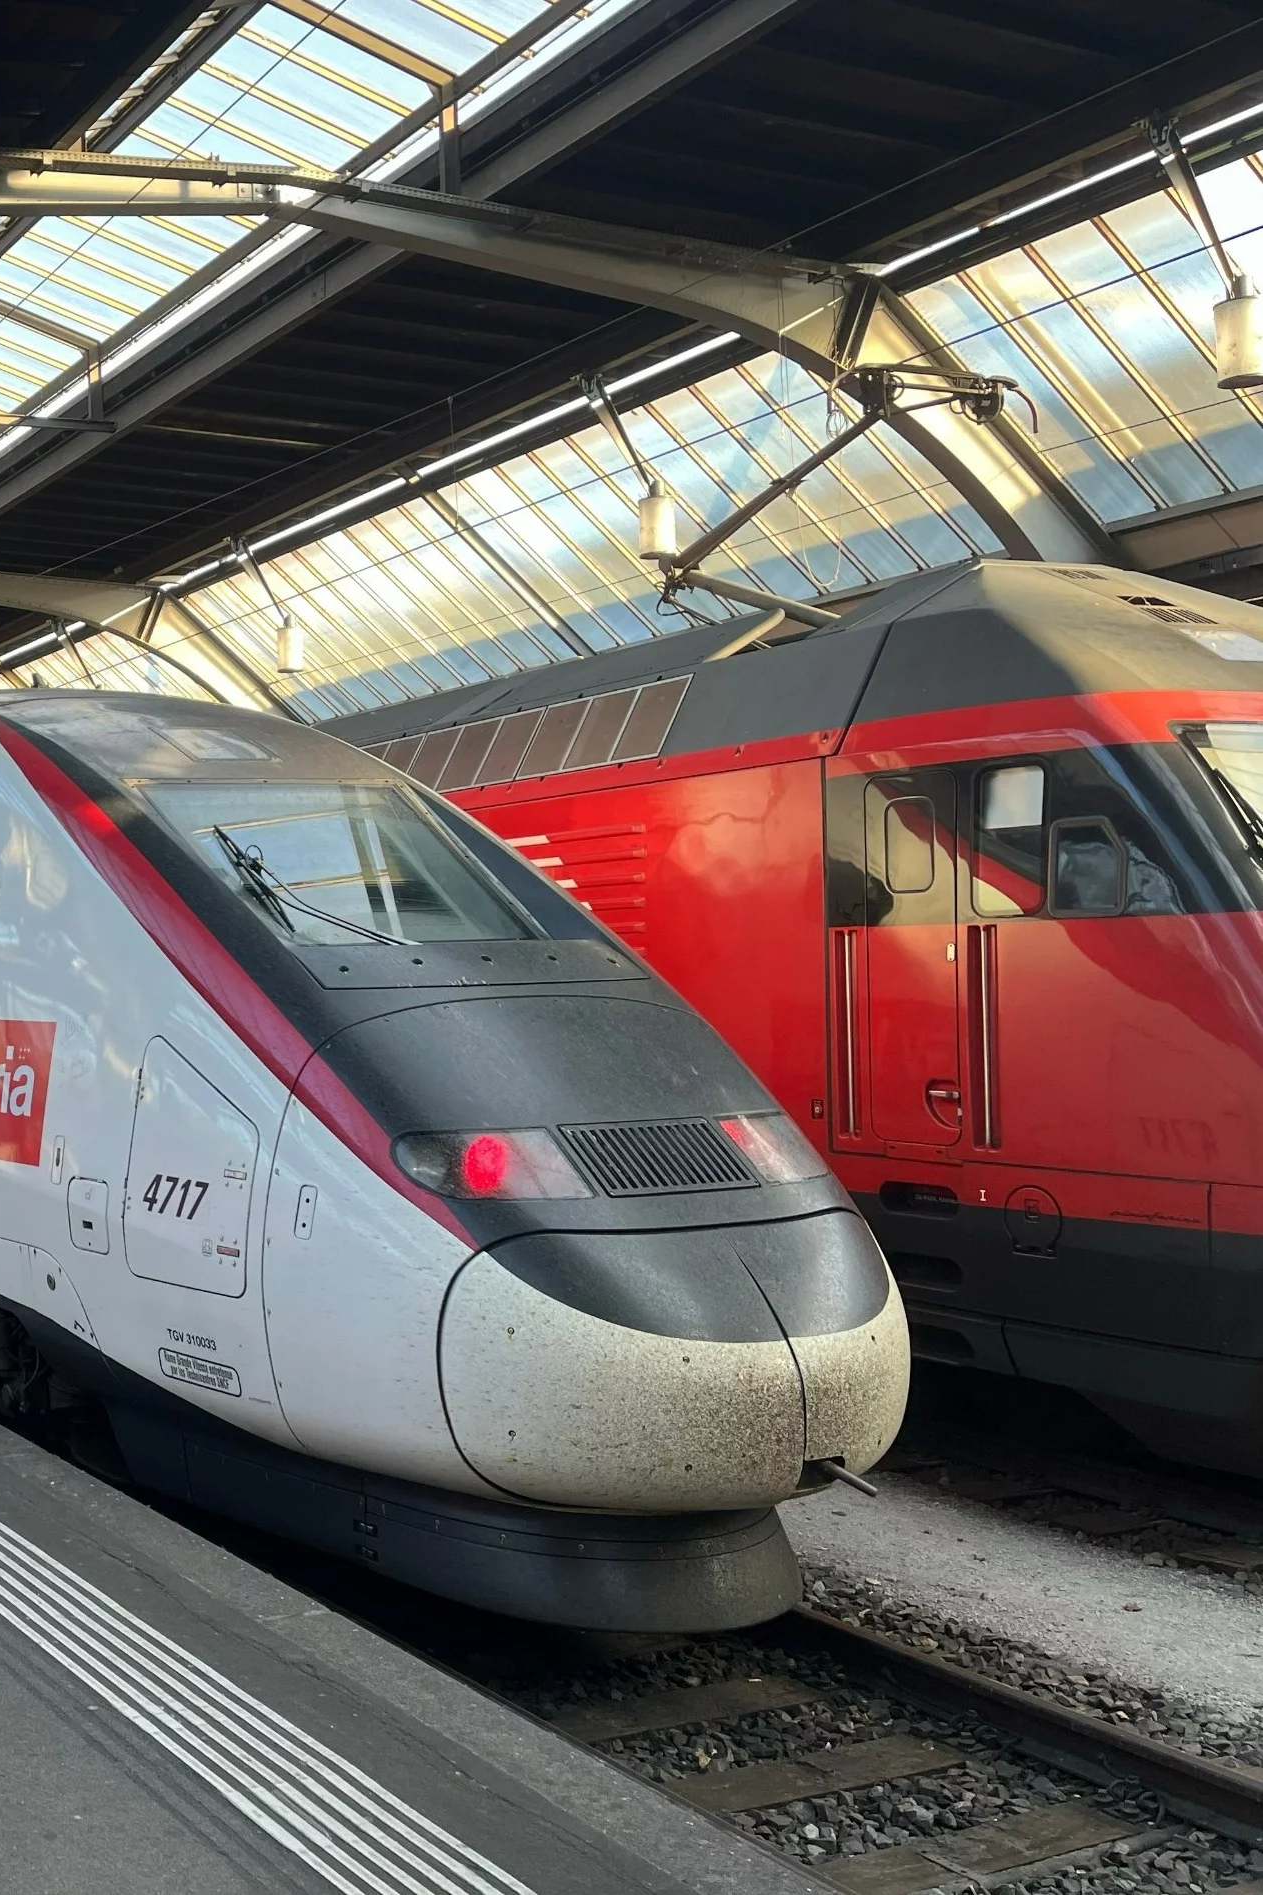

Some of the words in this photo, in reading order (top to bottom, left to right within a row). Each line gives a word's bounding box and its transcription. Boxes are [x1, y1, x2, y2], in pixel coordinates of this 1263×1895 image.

[142, 1173, 210, 1220] 4717
[167, 1328, 184, 1343] TGV
[186, 1333, 217, 1351] 310033
